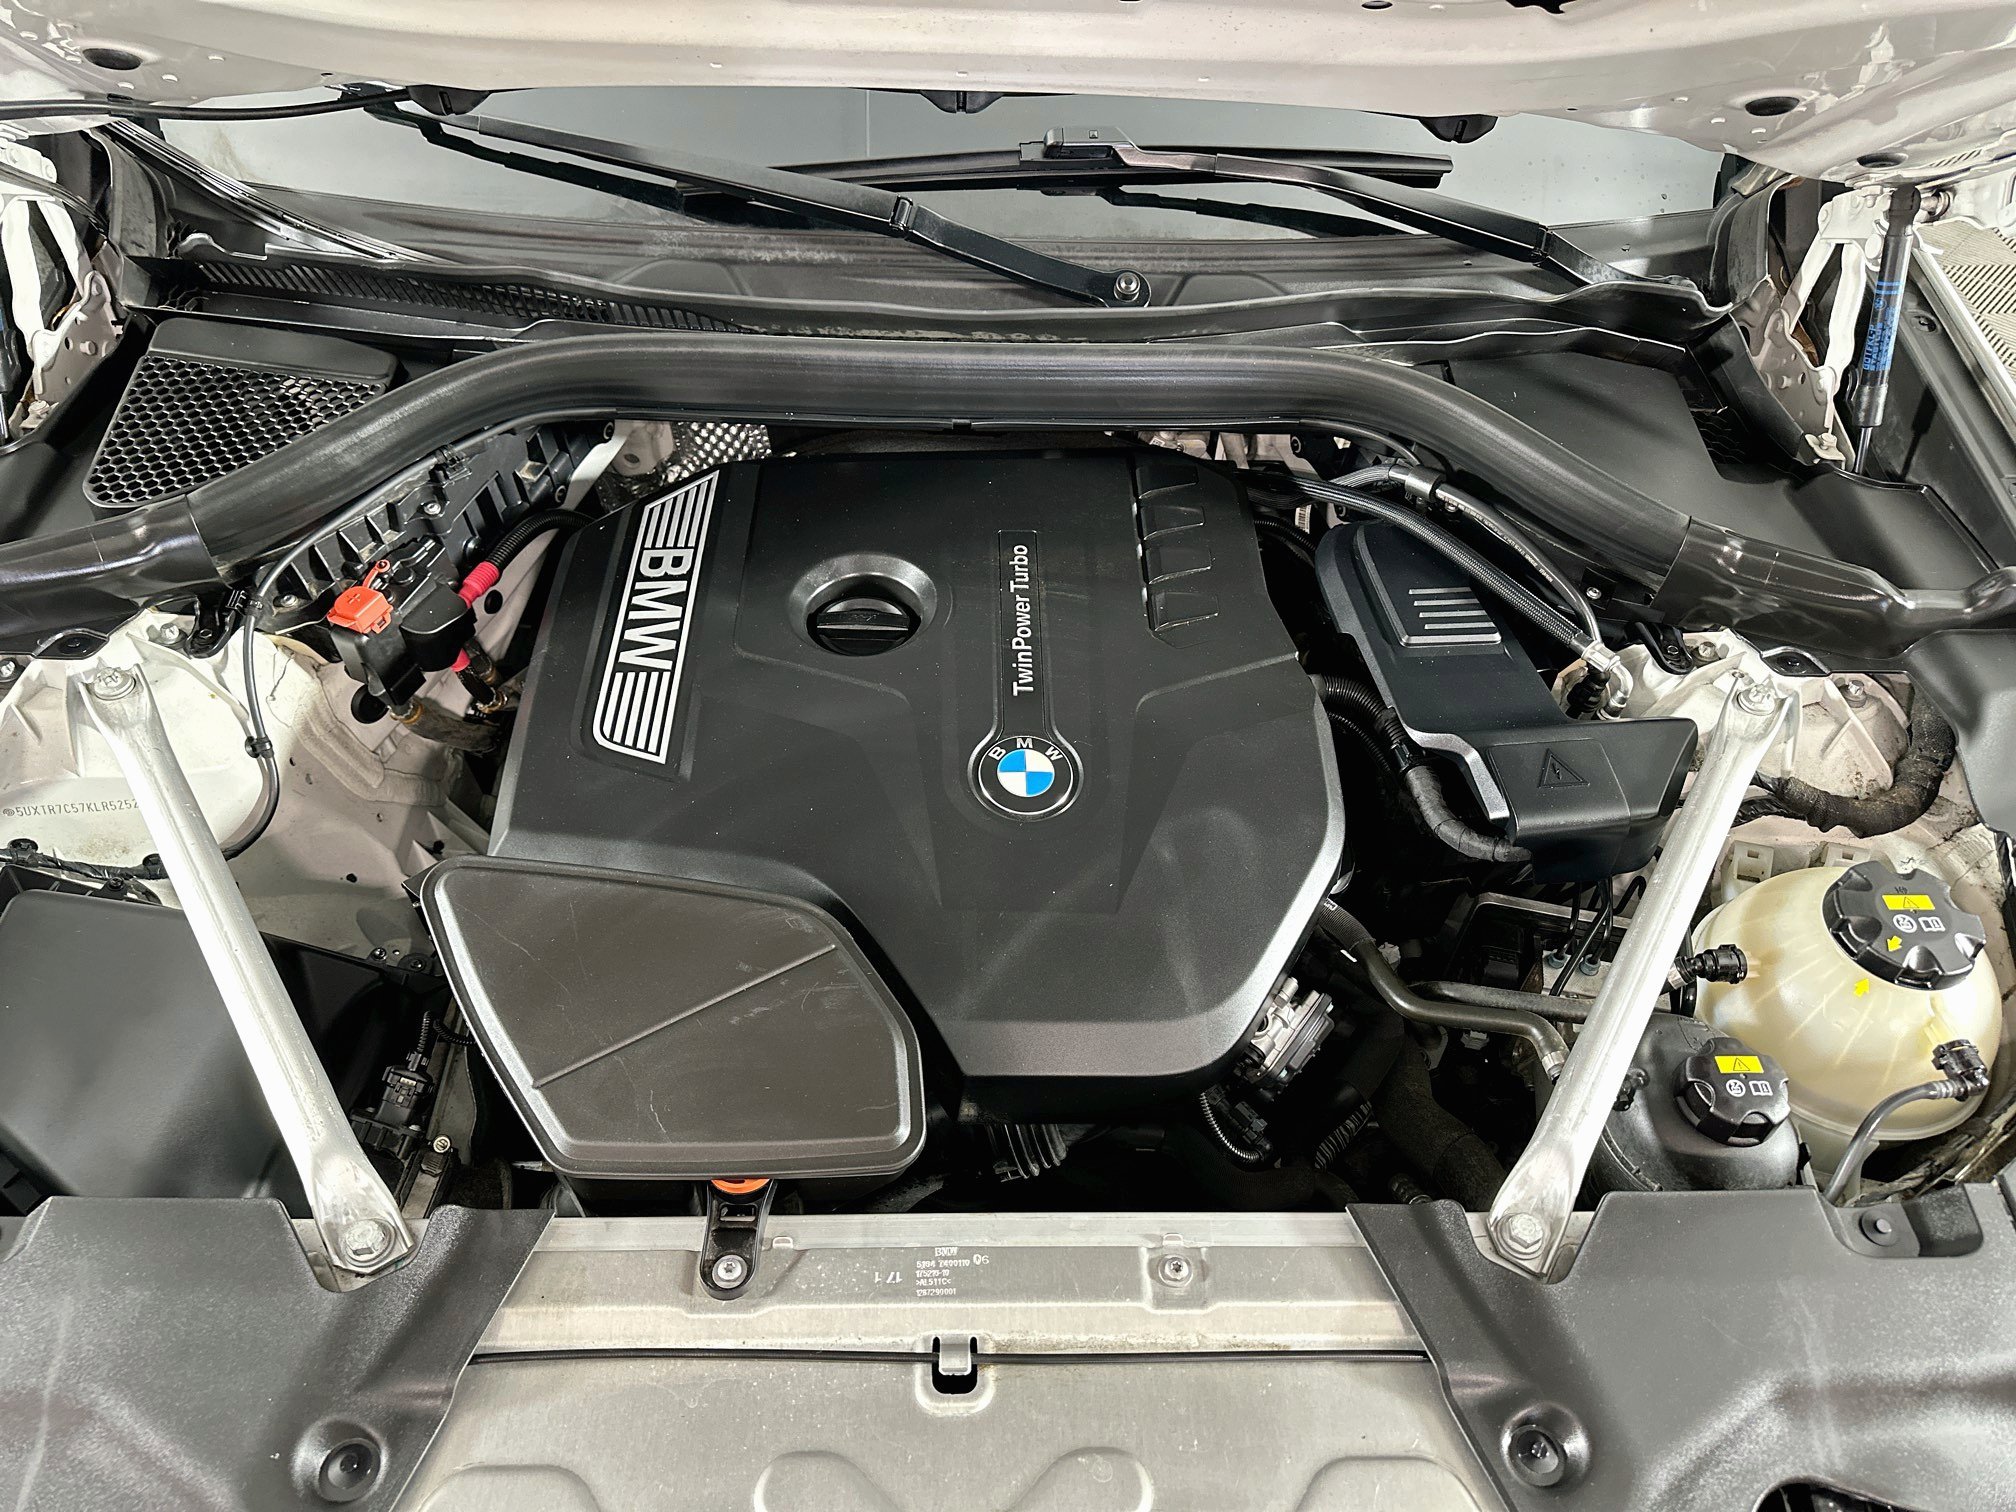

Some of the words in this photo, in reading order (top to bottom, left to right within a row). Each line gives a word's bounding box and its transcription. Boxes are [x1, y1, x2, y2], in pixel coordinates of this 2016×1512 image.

[1010, 544, 1029, 592] Turbo
[618, 548, 694, 670] BMW
[1012, 595, 1034, 697] TwinPower
[988, 737, 1063, 761] BMW
[935, 1246, 958, 1257] BMW
